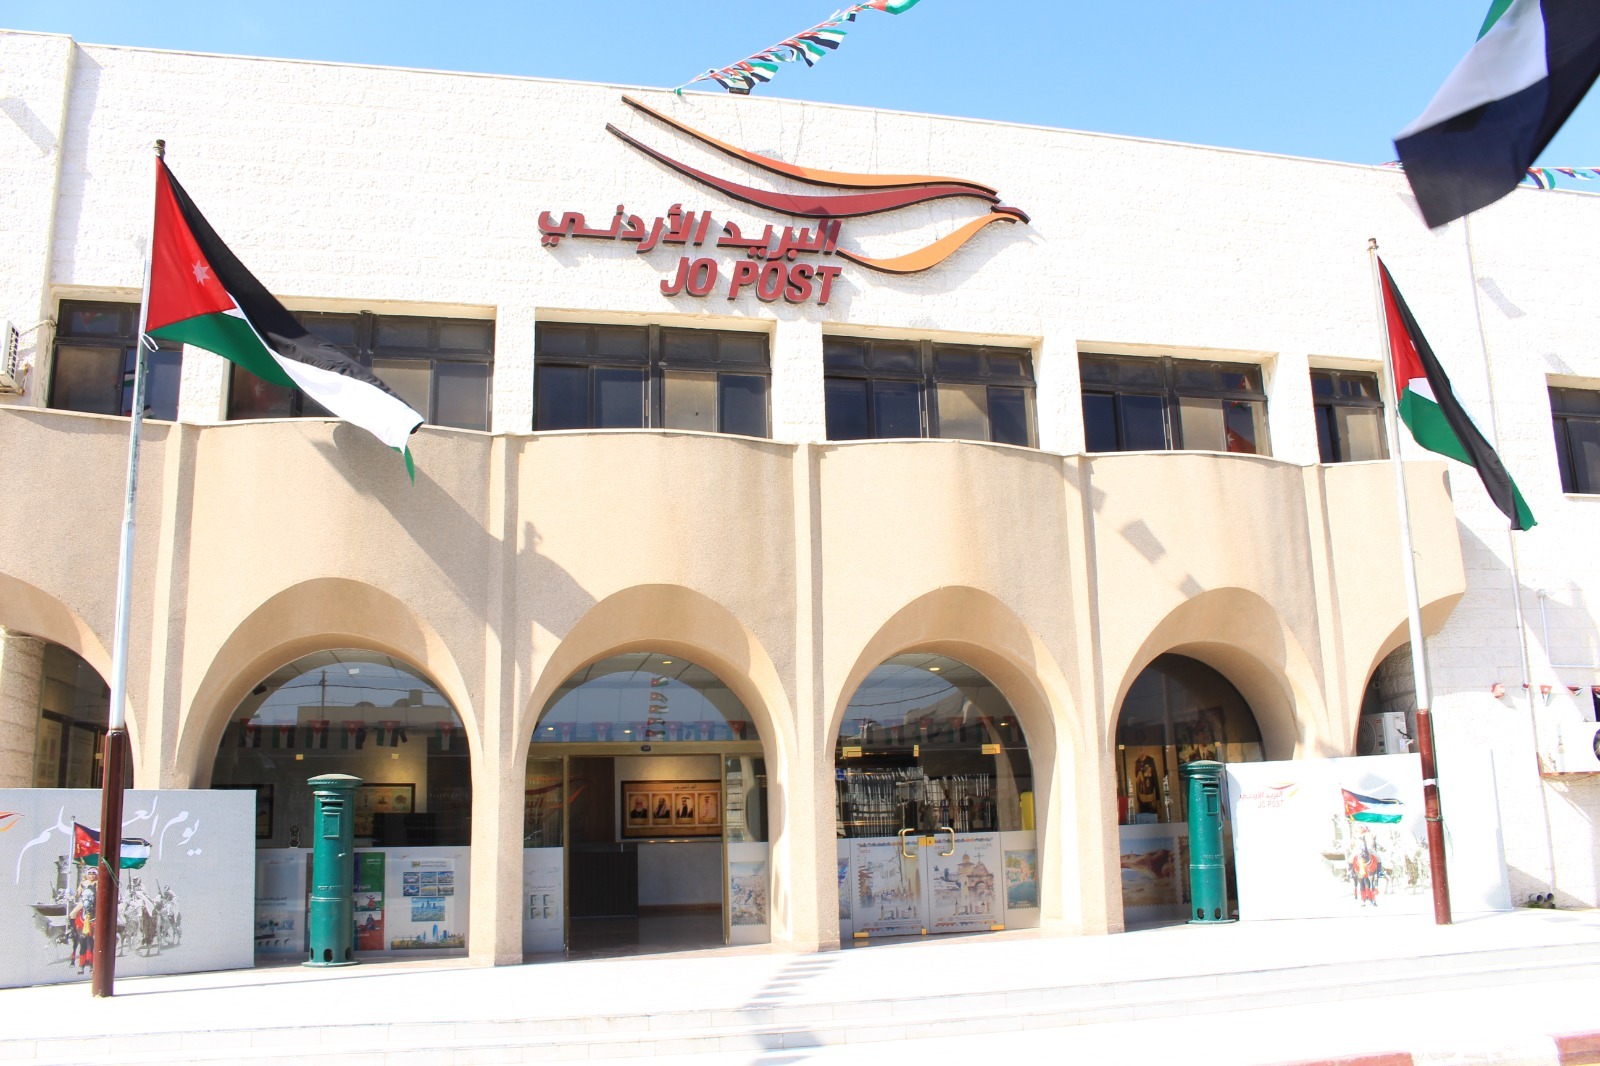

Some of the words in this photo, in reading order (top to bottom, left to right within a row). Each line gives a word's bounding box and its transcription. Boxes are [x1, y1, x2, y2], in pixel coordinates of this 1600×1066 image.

[537, 203, 712, 253] الأردني
[718, 218, 842, 261] البريد
[660, 256, 718, 298] JO
[727, 261, 842, 305] POST
[1267, 799, 1284, 808] POST
[158, 810, 202, 861] يوم
